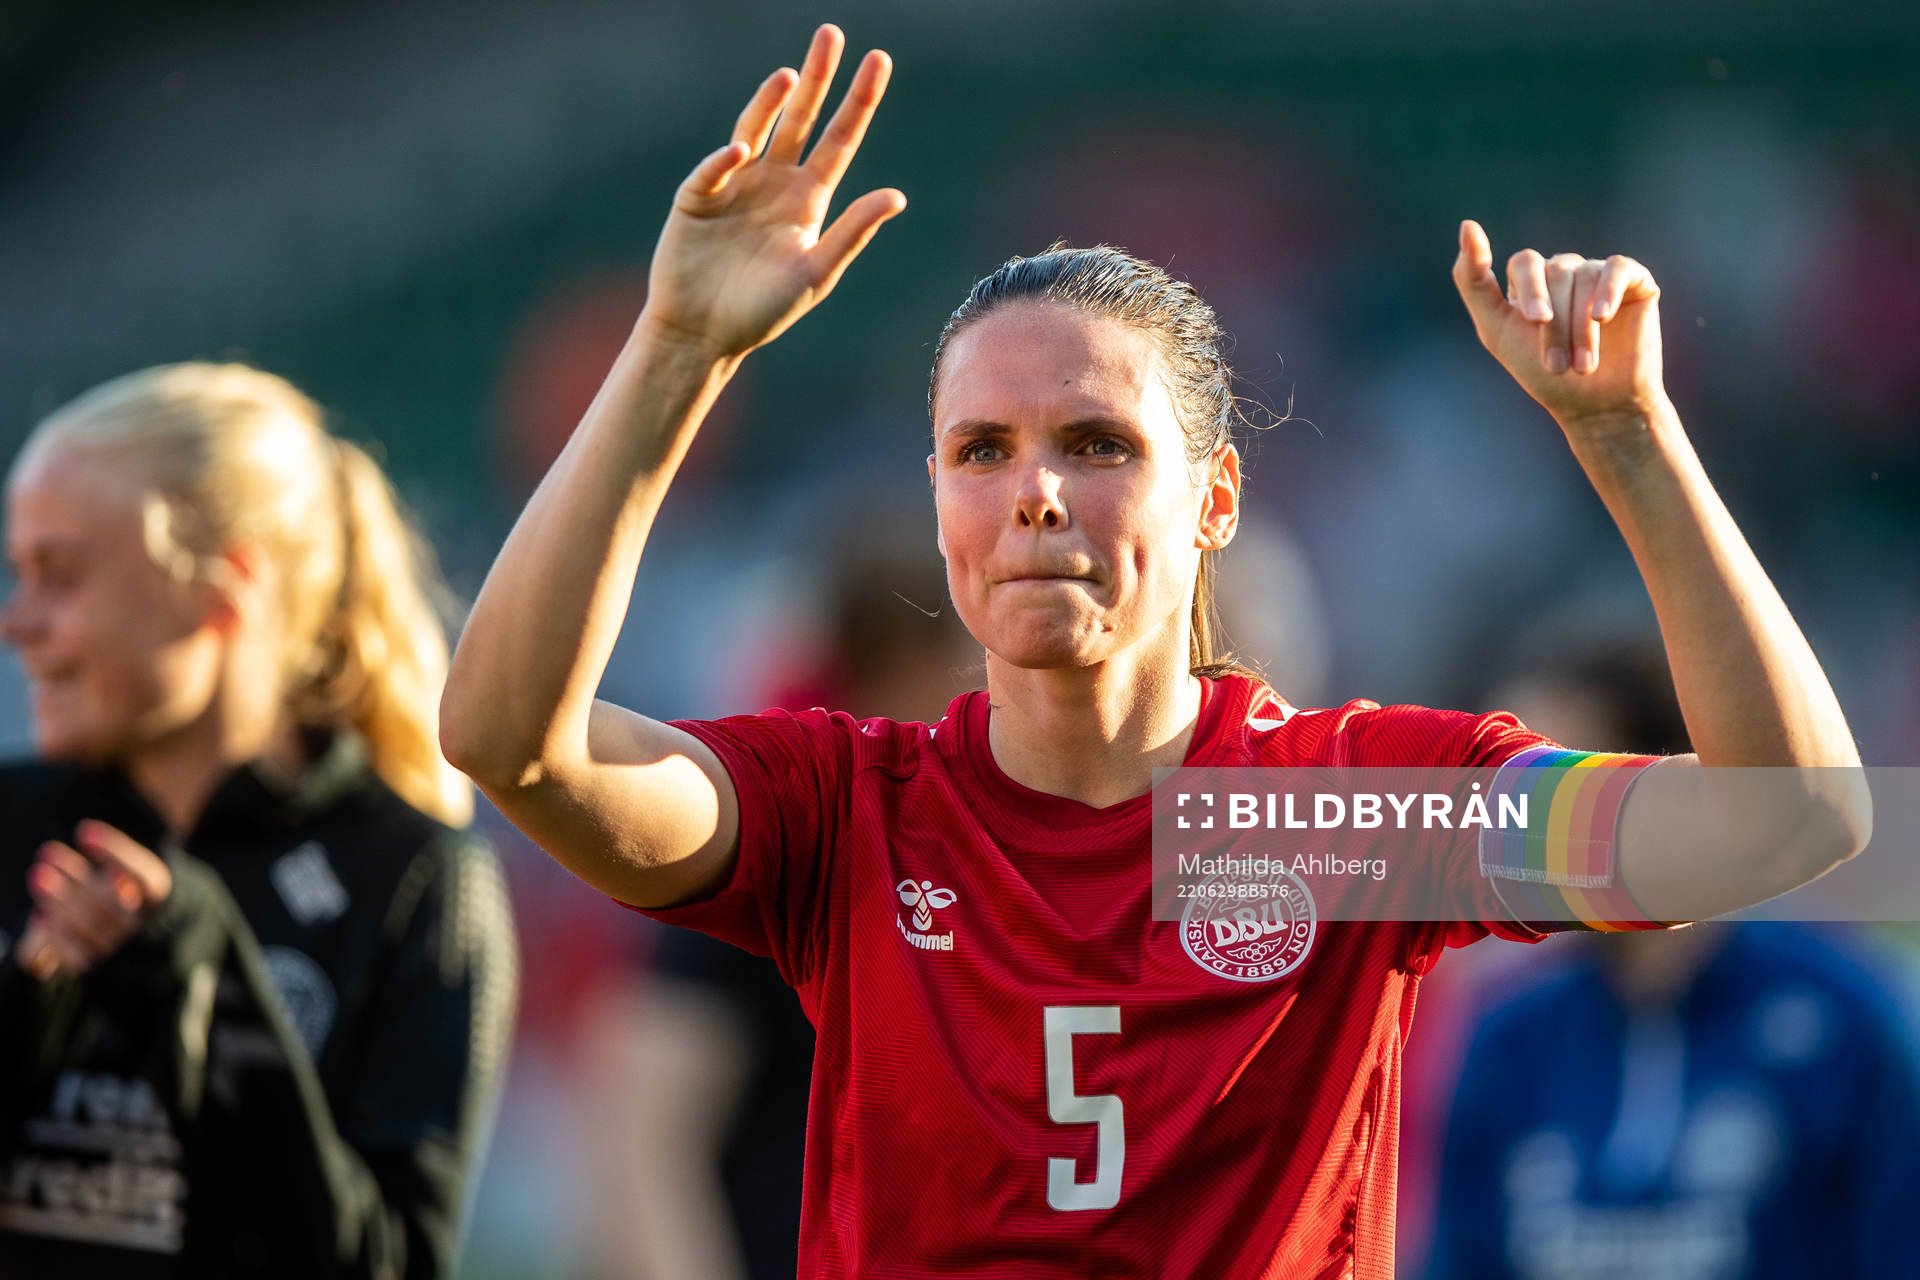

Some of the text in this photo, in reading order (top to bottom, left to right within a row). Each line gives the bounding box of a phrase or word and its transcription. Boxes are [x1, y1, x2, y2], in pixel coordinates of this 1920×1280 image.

[896, 912, 954, 951] hummel
[1188, 915, 1229, 972] DANSK
[1210, 899, 1289, 948] DBU
[1235, 956, 1288, 978] 1889
[1043, 1005, 1126, 1212] 5
